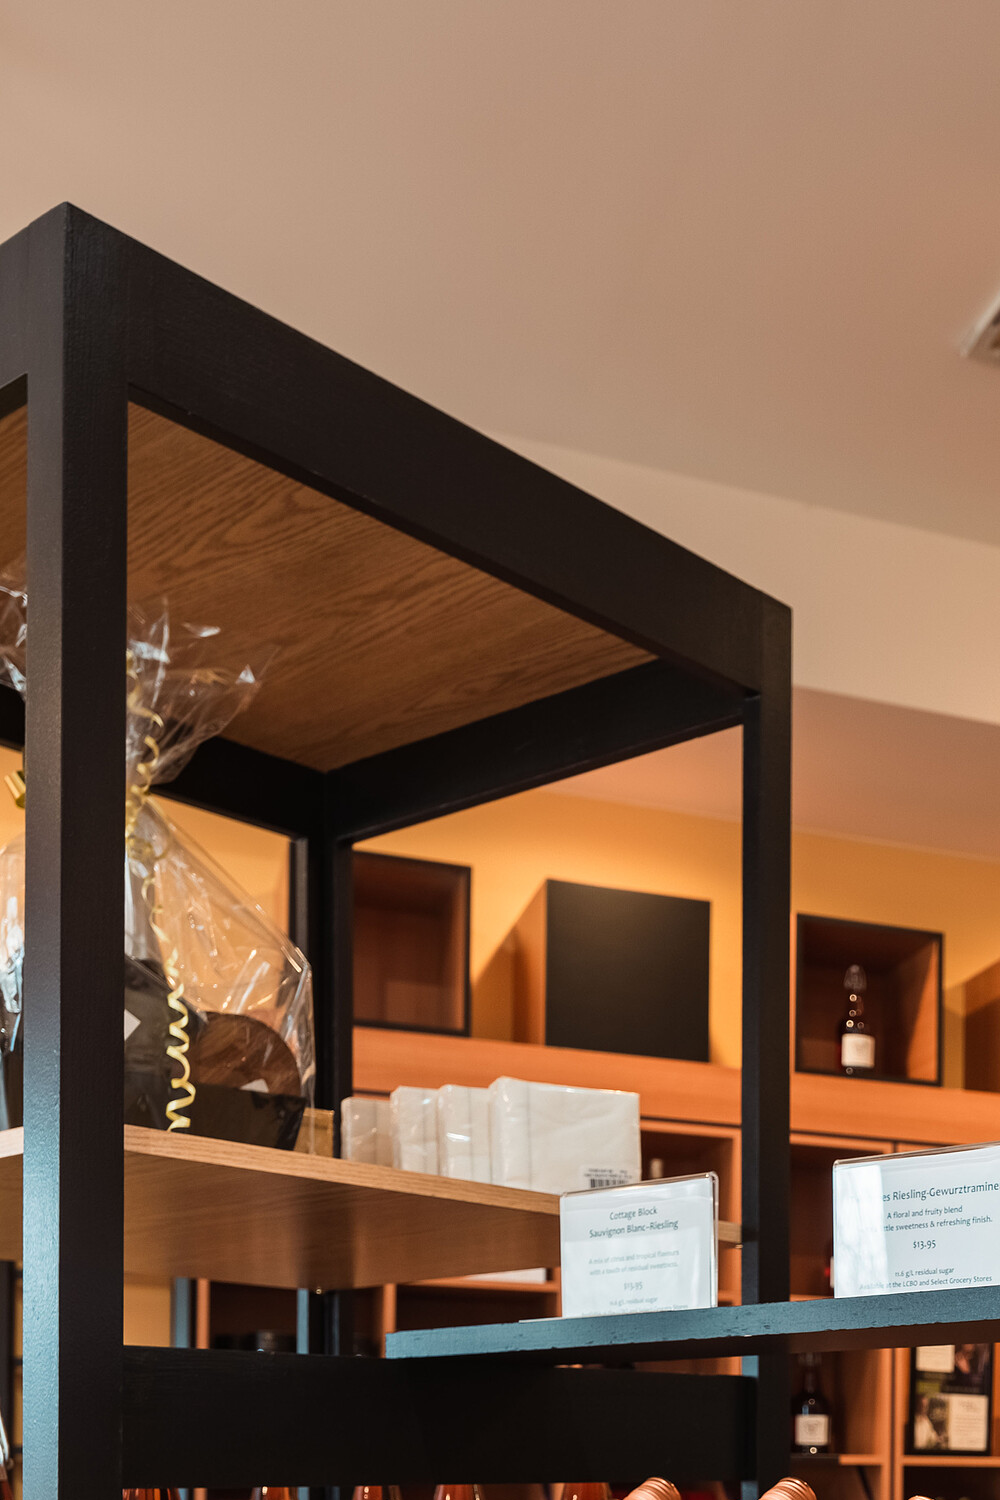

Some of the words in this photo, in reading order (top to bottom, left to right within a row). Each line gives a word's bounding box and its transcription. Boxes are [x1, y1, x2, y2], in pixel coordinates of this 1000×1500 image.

[609, 1211, 636, 1221] Cottage
[638, 1206, 658, 1217] Block
[893, 1210, 911, 1219] floral
[912, 1209, 923, 1217] and
[925, 1207, 942, 1217] fruity
[944, 1205, 963, 1215] blend
[895, 1222, 929, 1231] sweetness
[936, 1217, 971, 1228] refreshing
[972, 1215, 993, 1224] finish.
[589, 1227, 626, 1239] Sauvignon
[913, 1239, 937, 1250] $13.95
[915, 1267, 938, 1276] residual
[939, 1267, 955, 1276] sugar
[903, 1280, 918, 1288] LCBO
[919, 1279, 930, 1287] and
[930, 1278, 948, 1286] Select
[949, 1276, 972, 1286] Grocery
[973, 1275, 993, 1284] Stores
